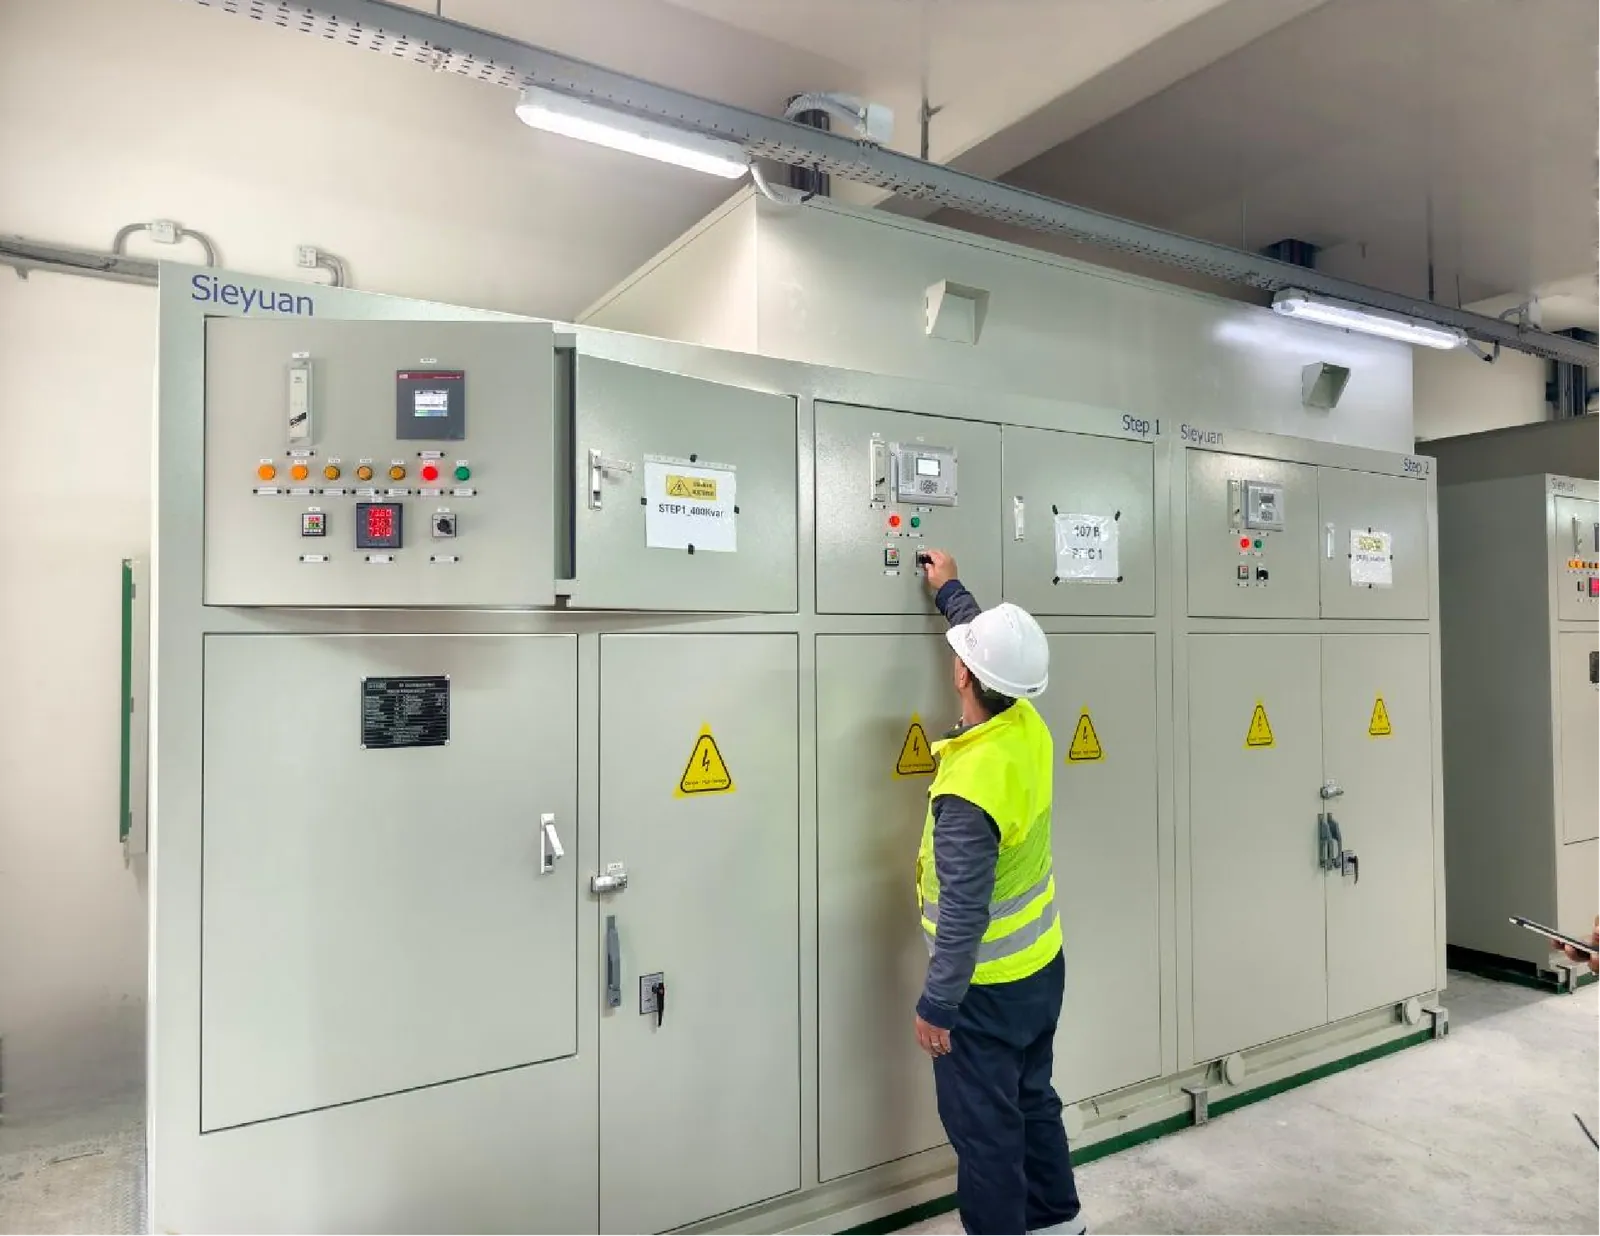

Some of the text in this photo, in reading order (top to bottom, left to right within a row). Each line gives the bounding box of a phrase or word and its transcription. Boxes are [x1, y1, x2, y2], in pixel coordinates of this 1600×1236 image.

[191, 274, 314, 316] Sieyuan
[1122, 414, 1161, 437] Step 1
[1181, 423, 1224, 445] Sieyuan
[1403, 457, 1430, 477] Step 2
[1093, 526, 1100, 537] B
